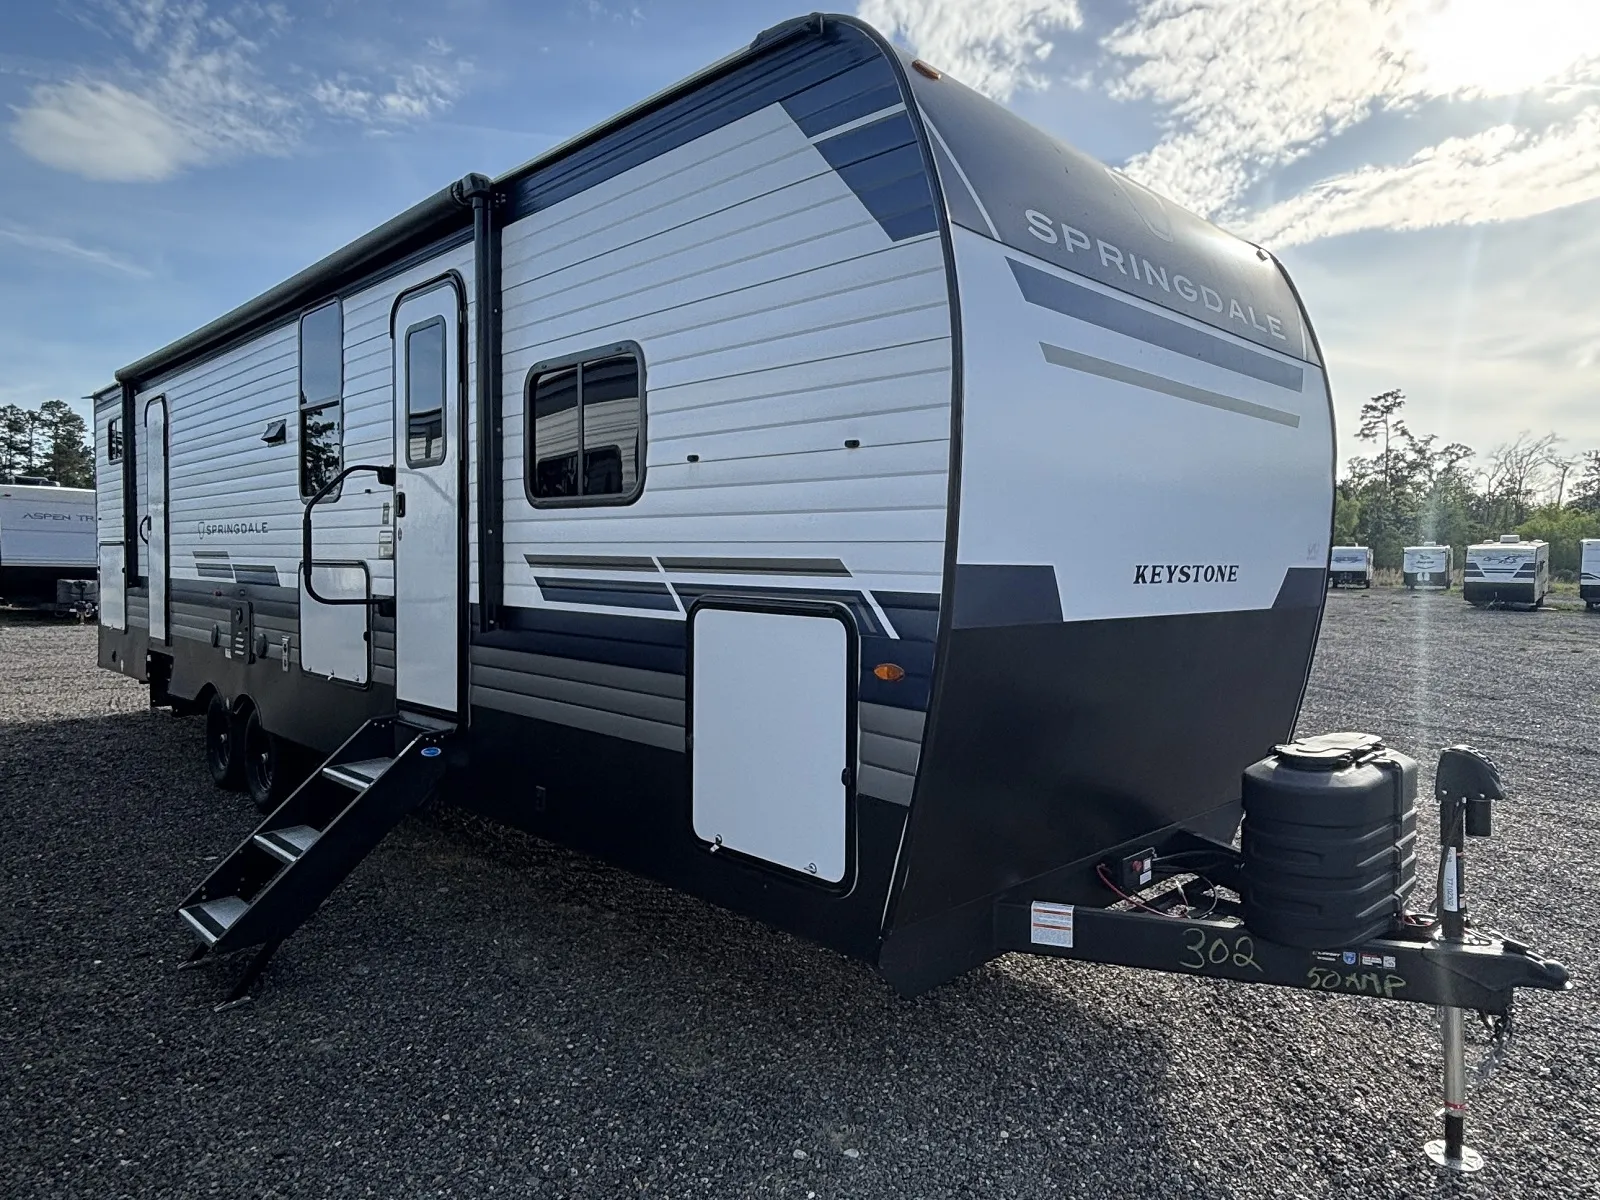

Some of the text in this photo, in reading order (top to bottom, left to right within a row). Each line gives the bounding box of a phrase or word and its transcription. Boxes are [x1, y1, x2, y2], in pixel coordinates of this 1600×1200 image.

[1025, 209, 1287, 341] SPRINGDALE
[22, 512, 71, 521] ASPEN
[206, 521, 269, 535] SPRINGDALE
[1133, 564, 1240, 585] KEYSTONE
[1179, 927, 1264, 973] 302
